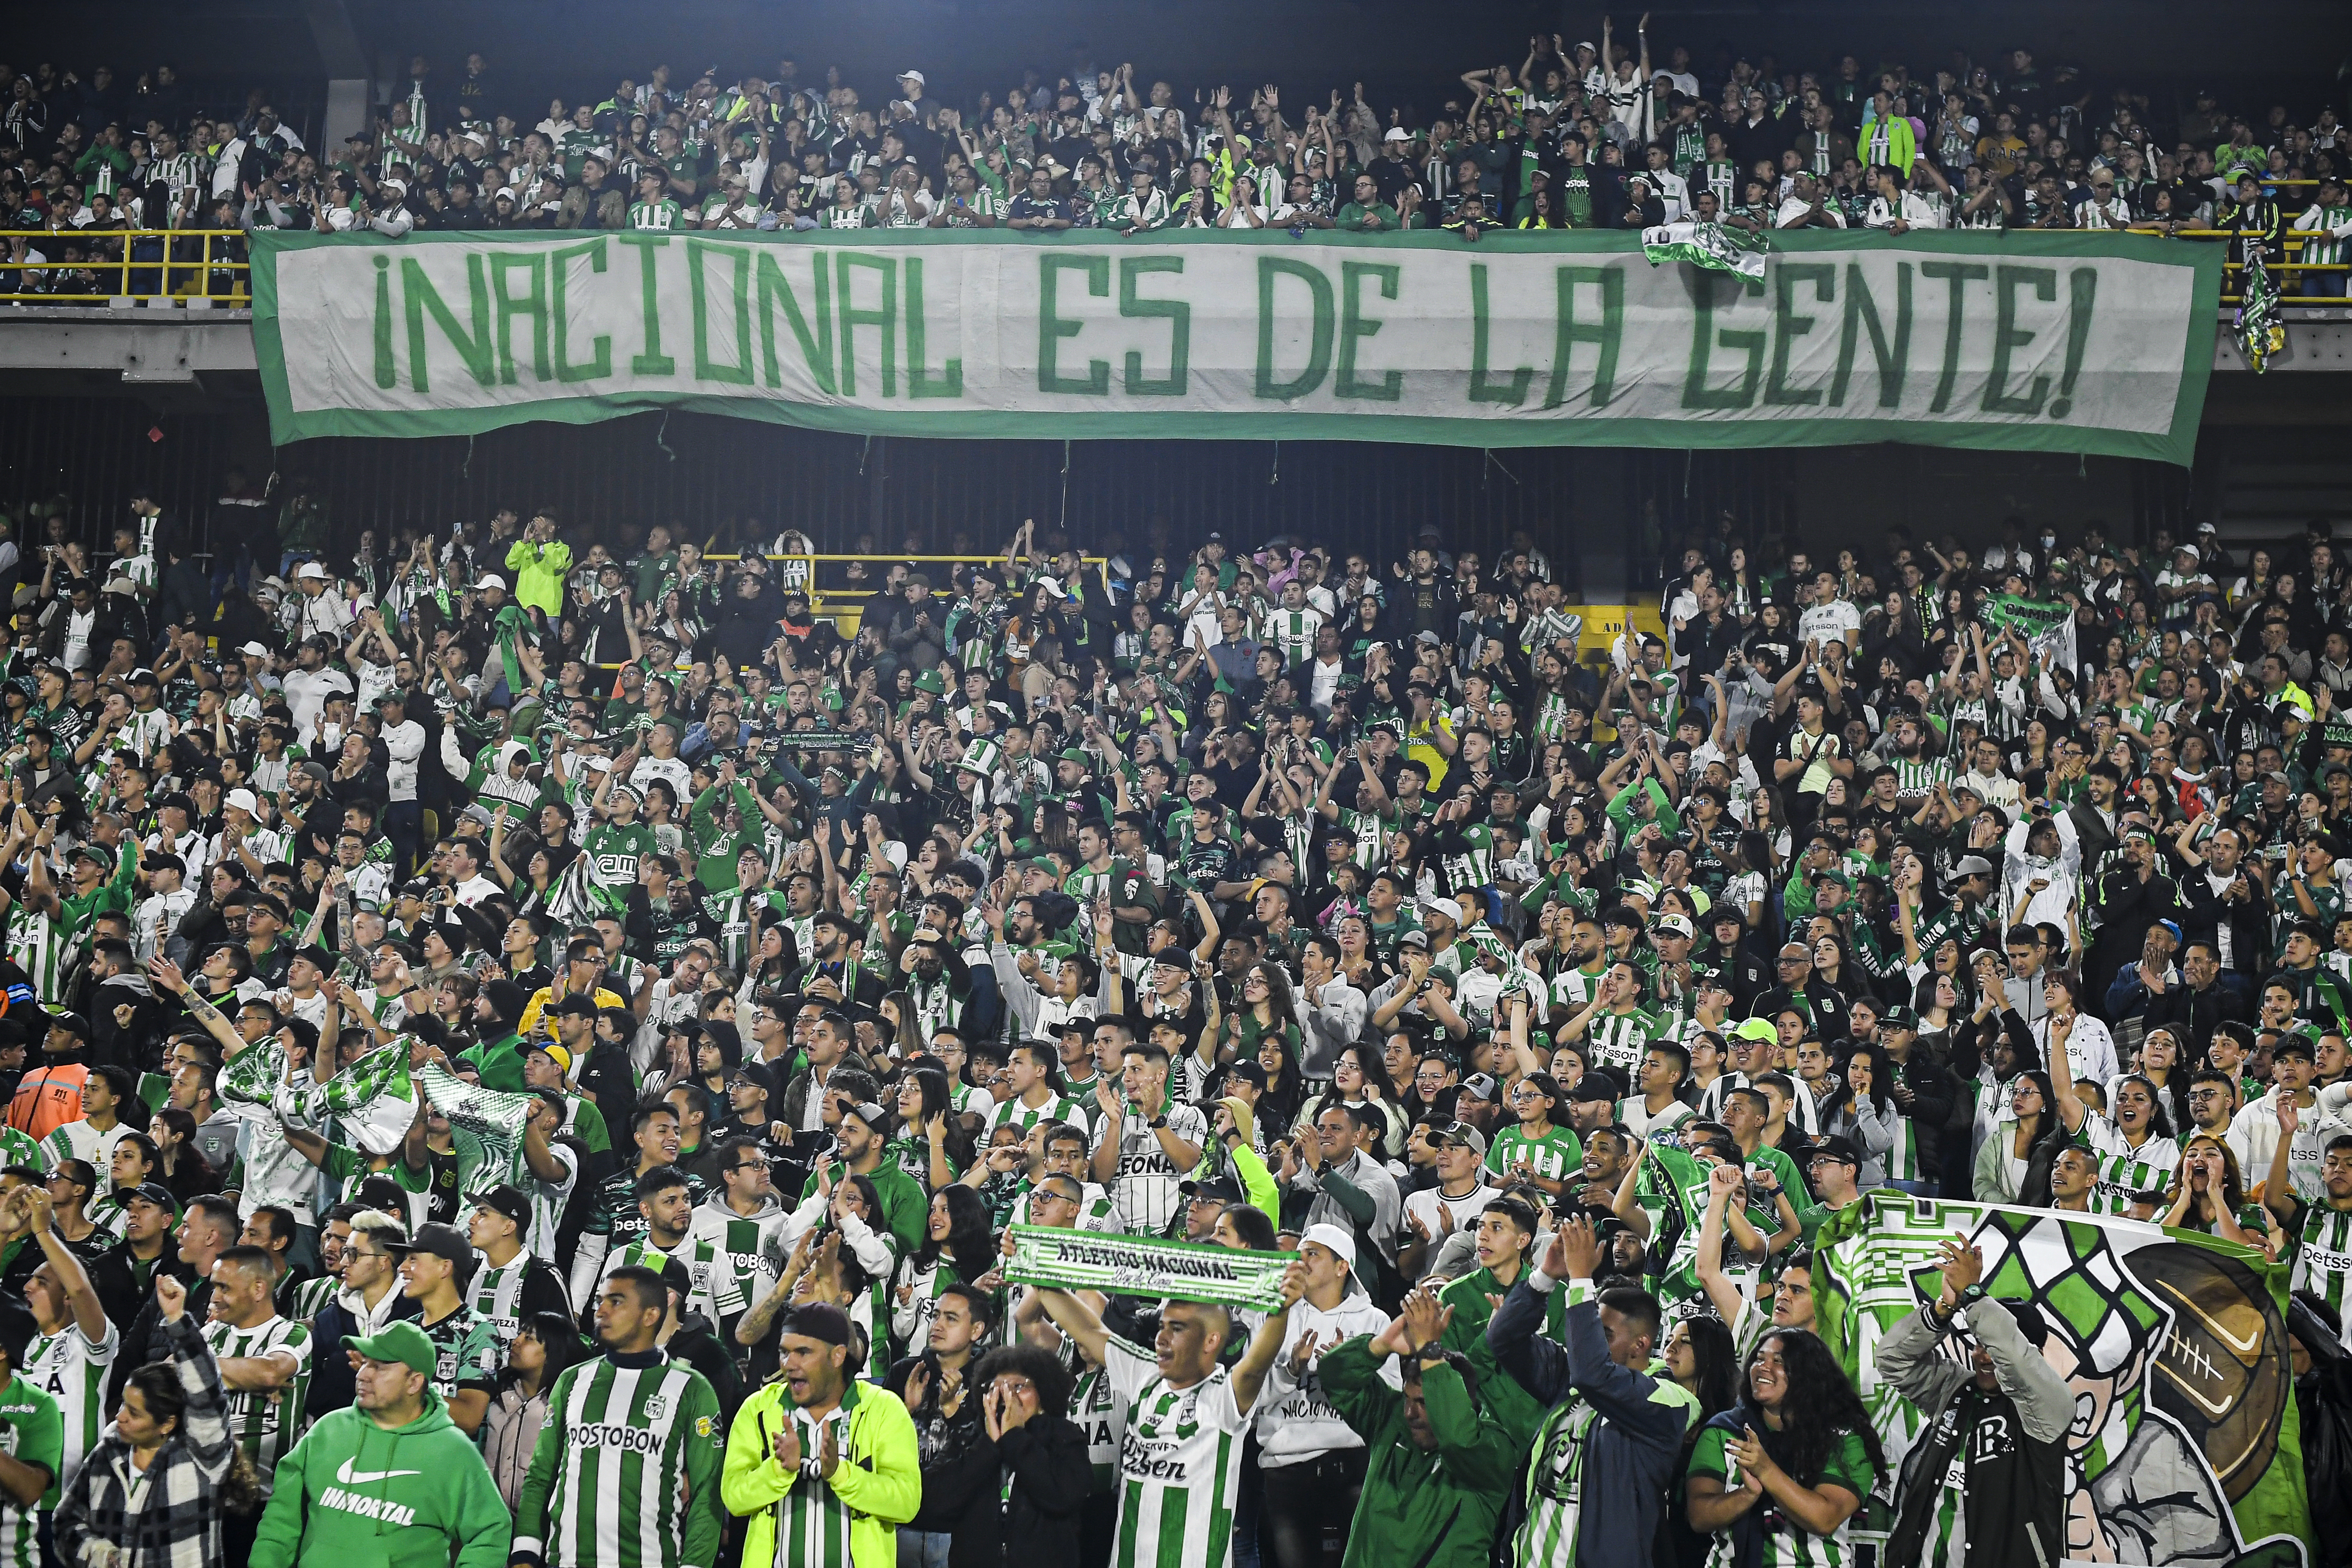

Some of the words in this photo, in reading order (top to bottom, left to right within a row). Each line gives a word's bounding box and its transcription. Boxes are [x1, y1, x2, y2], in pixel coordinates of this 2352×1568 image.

[1037, 253, 1191, 397] ES
[1254, 255, 1401, 402] DE
[1467, 263, 1625, 409] LA
[1681, 261, 2098, 420] GENTE!
[1603, 622, 1622, 633] AD
[55, 1089, 68, 1099] 911
[2291, 1147, 2318, 1161] tss
[605, 1179, 632, 1191] POSTOBON
[1057, 1242, 1140, 1269] ATLETICO
[1142, 1253, 1238, 1281] NACIONAL
[568, 1422, 663, 1456] POSTOBON
[319, 1487, 416, 1527] INMORTAL
